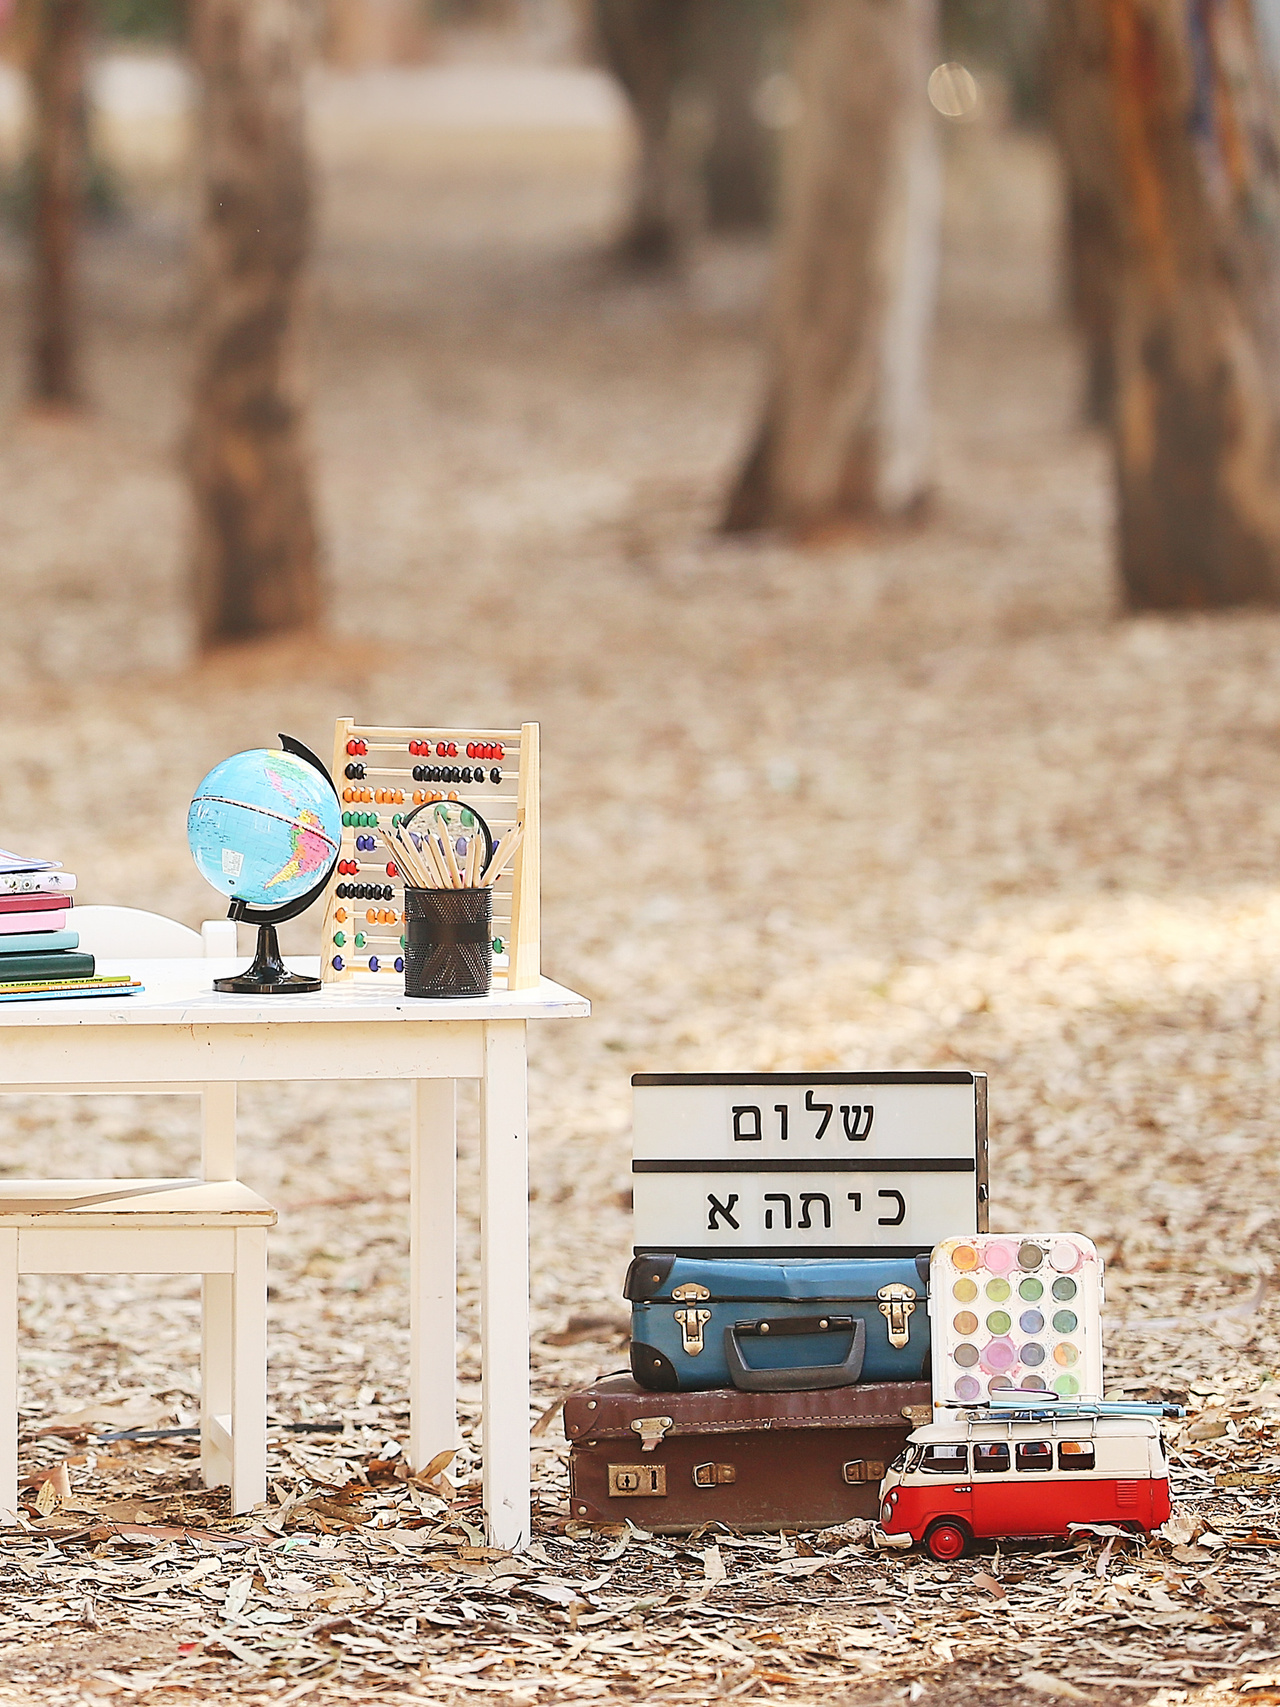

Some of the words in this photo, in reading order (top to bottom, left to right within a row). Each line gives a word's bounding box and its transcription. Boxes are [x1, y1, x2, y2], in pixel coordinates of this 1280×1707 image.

[731, 1089, 874, 1142] שלום
[706, 1192, 741, 1231] א
[763, 1189, 907, 1230] כיתה
